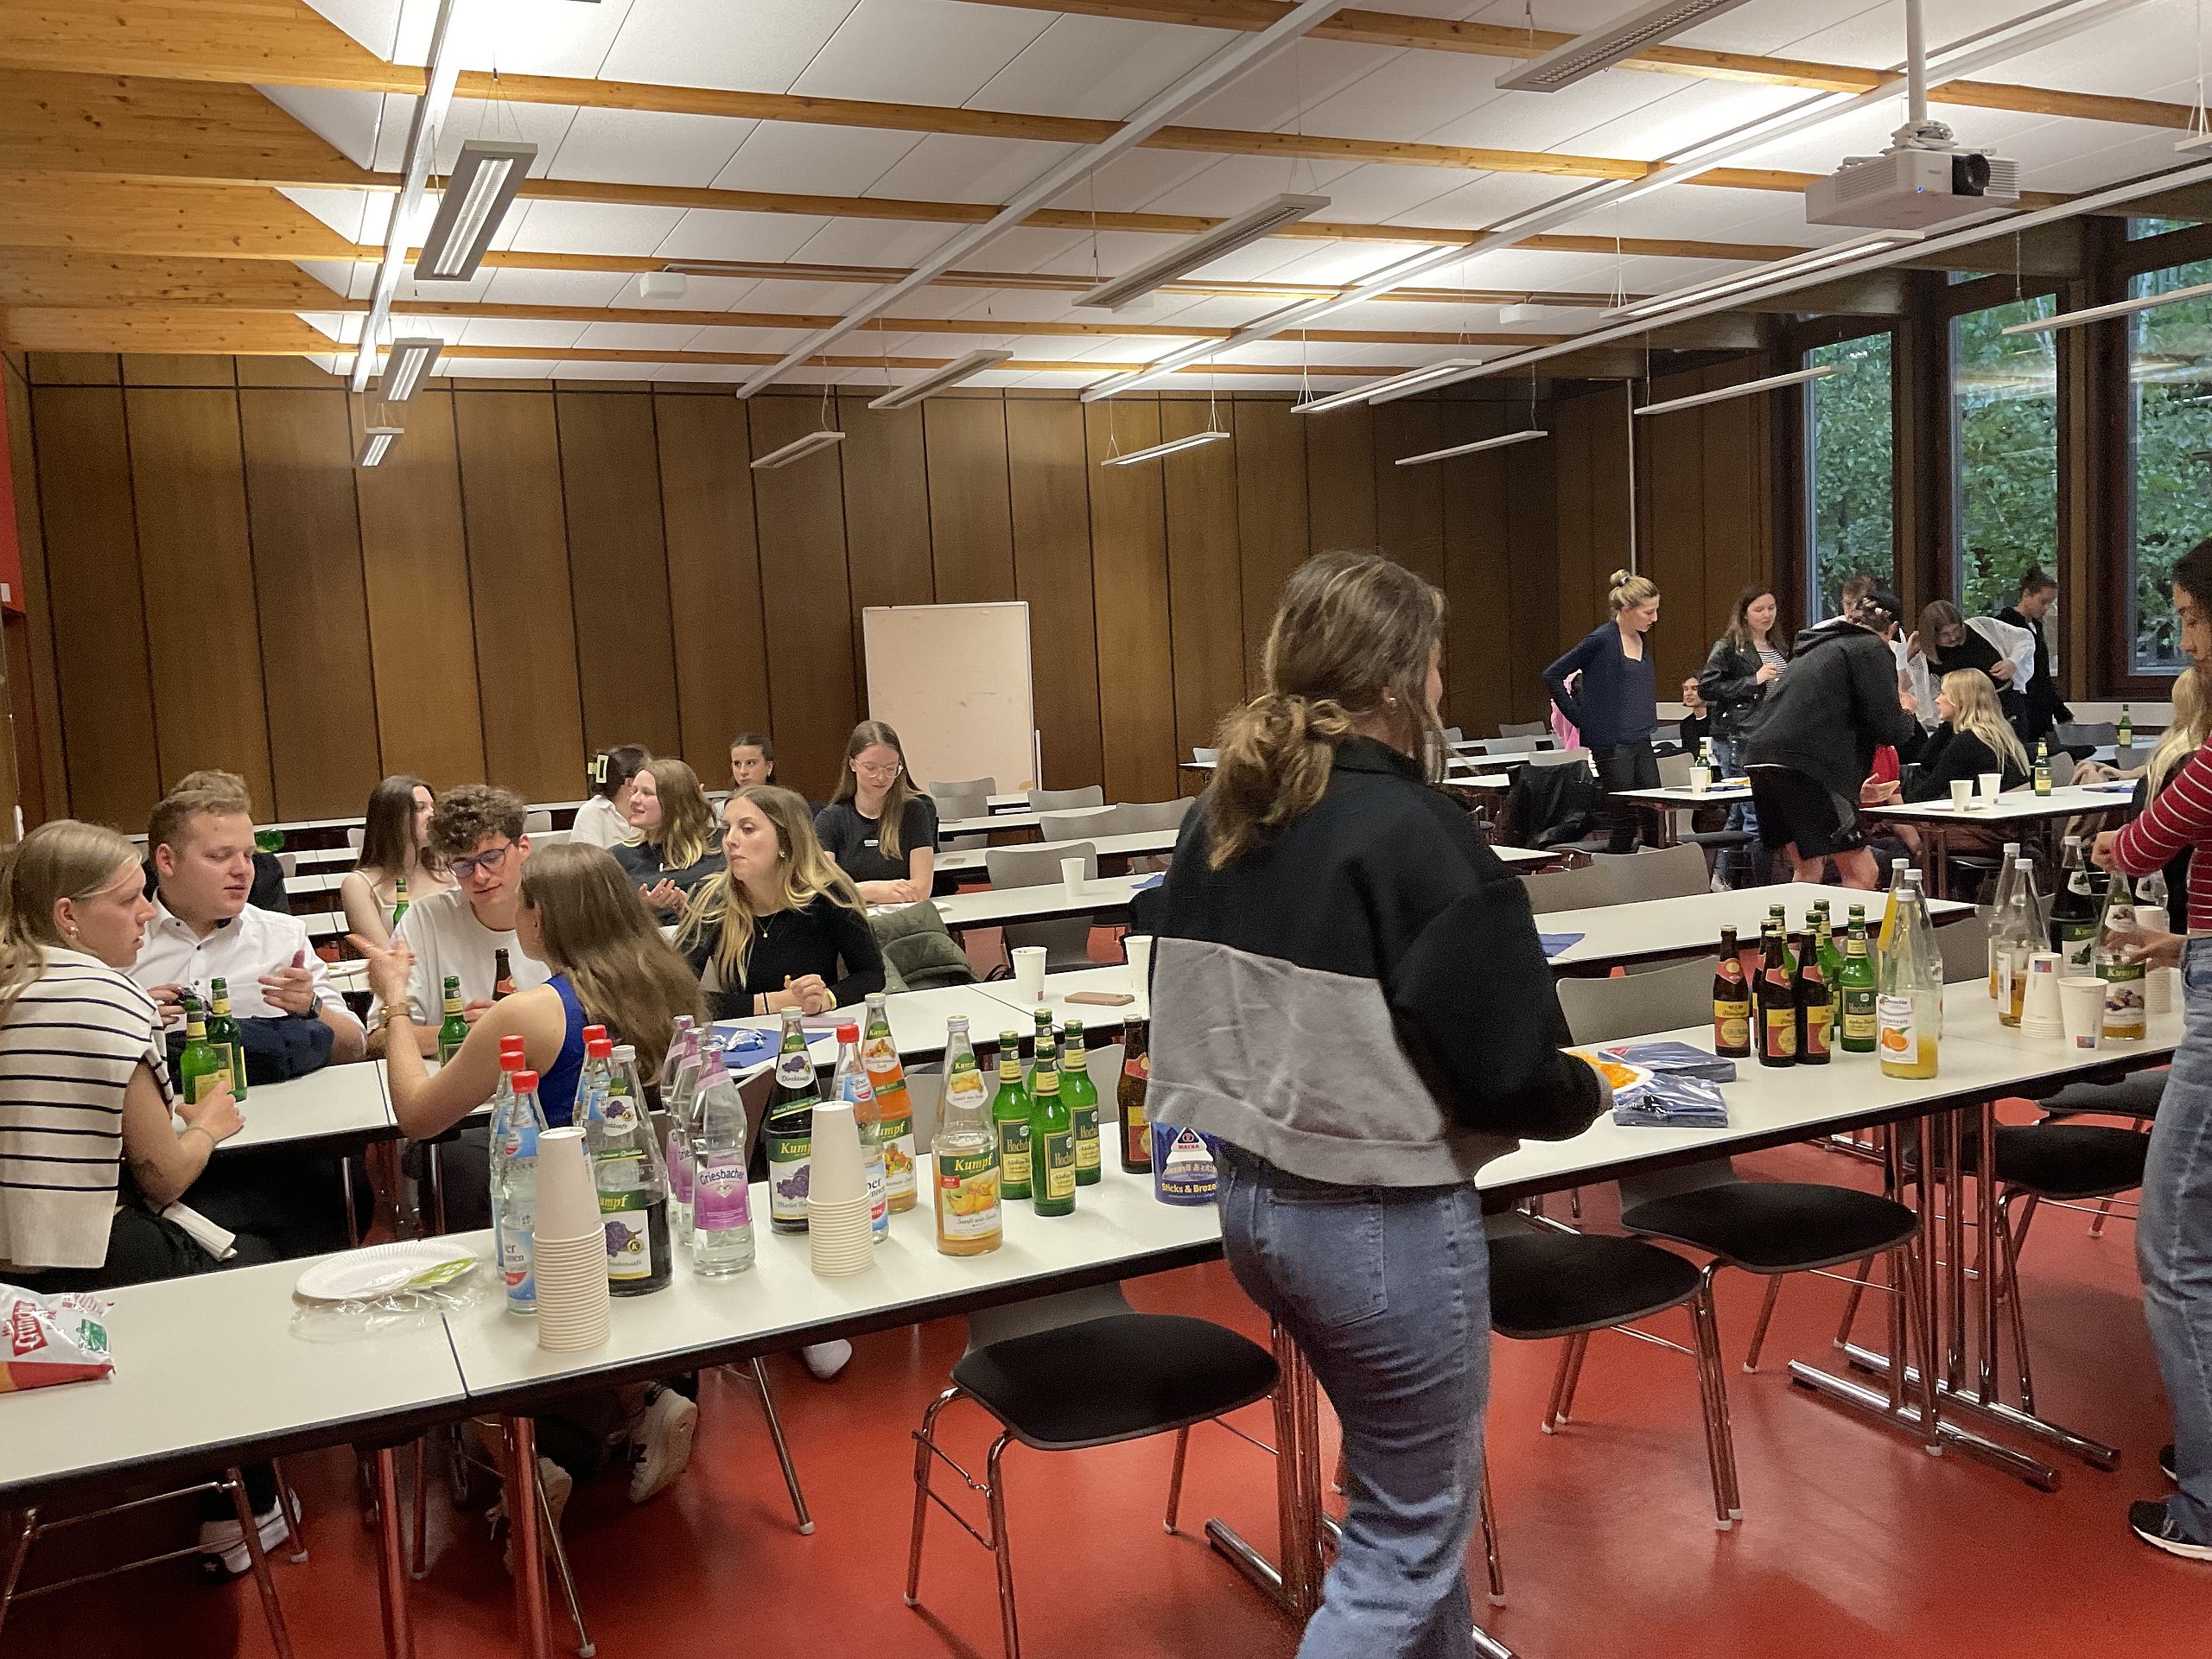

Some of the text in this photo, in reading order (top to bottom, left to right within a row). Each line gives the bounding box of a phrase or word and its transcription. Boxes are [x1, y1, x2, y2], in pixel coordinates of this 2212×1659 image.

[954, 1152, 994, 1172] Kumpf
[699, 1167, 744, 1185] Griesbacher
[598, 1194, 629, 1211] umpf
